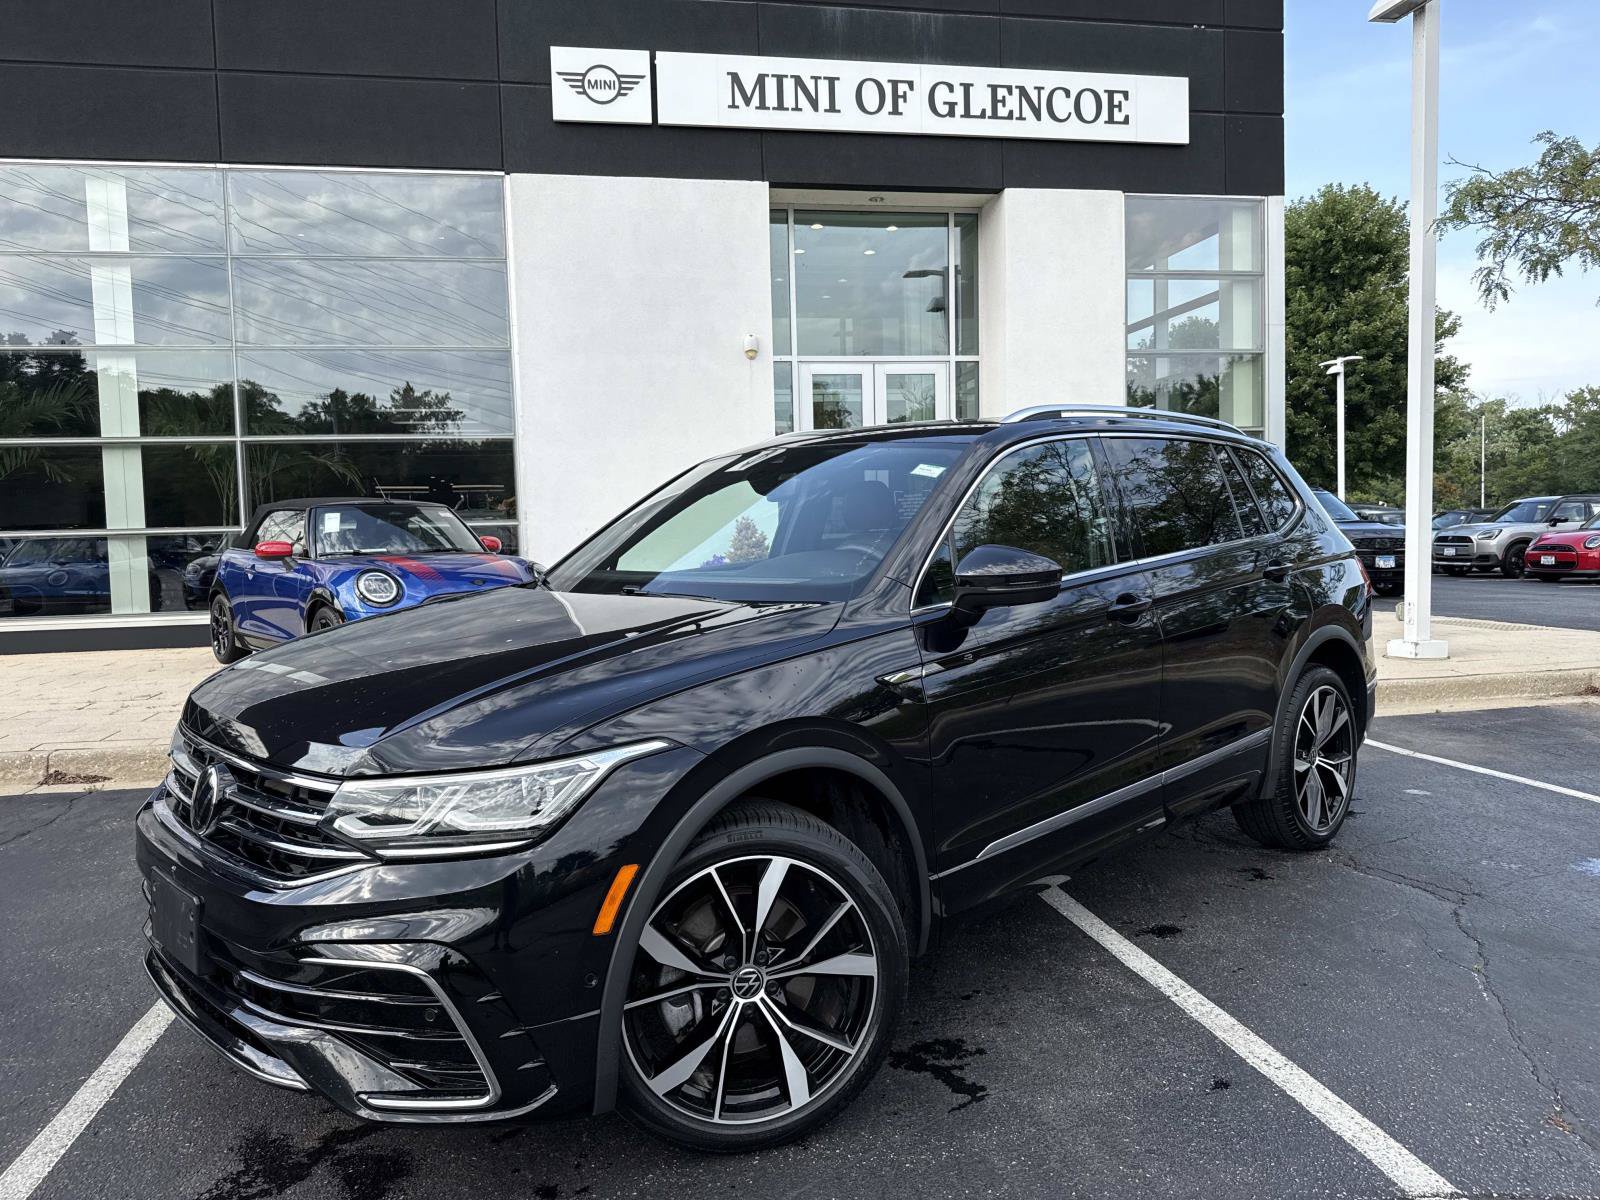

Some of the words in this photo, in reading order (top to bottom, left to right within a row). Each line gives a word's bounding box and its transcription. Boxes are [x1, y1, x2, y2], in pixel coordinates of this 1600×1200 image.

[587, 79, 616, 91] MINI
[727, 71, 842, 114] MINI
[855, 77, 915, 116] OF
[927, 80, 1130, 125] GLENCOE
